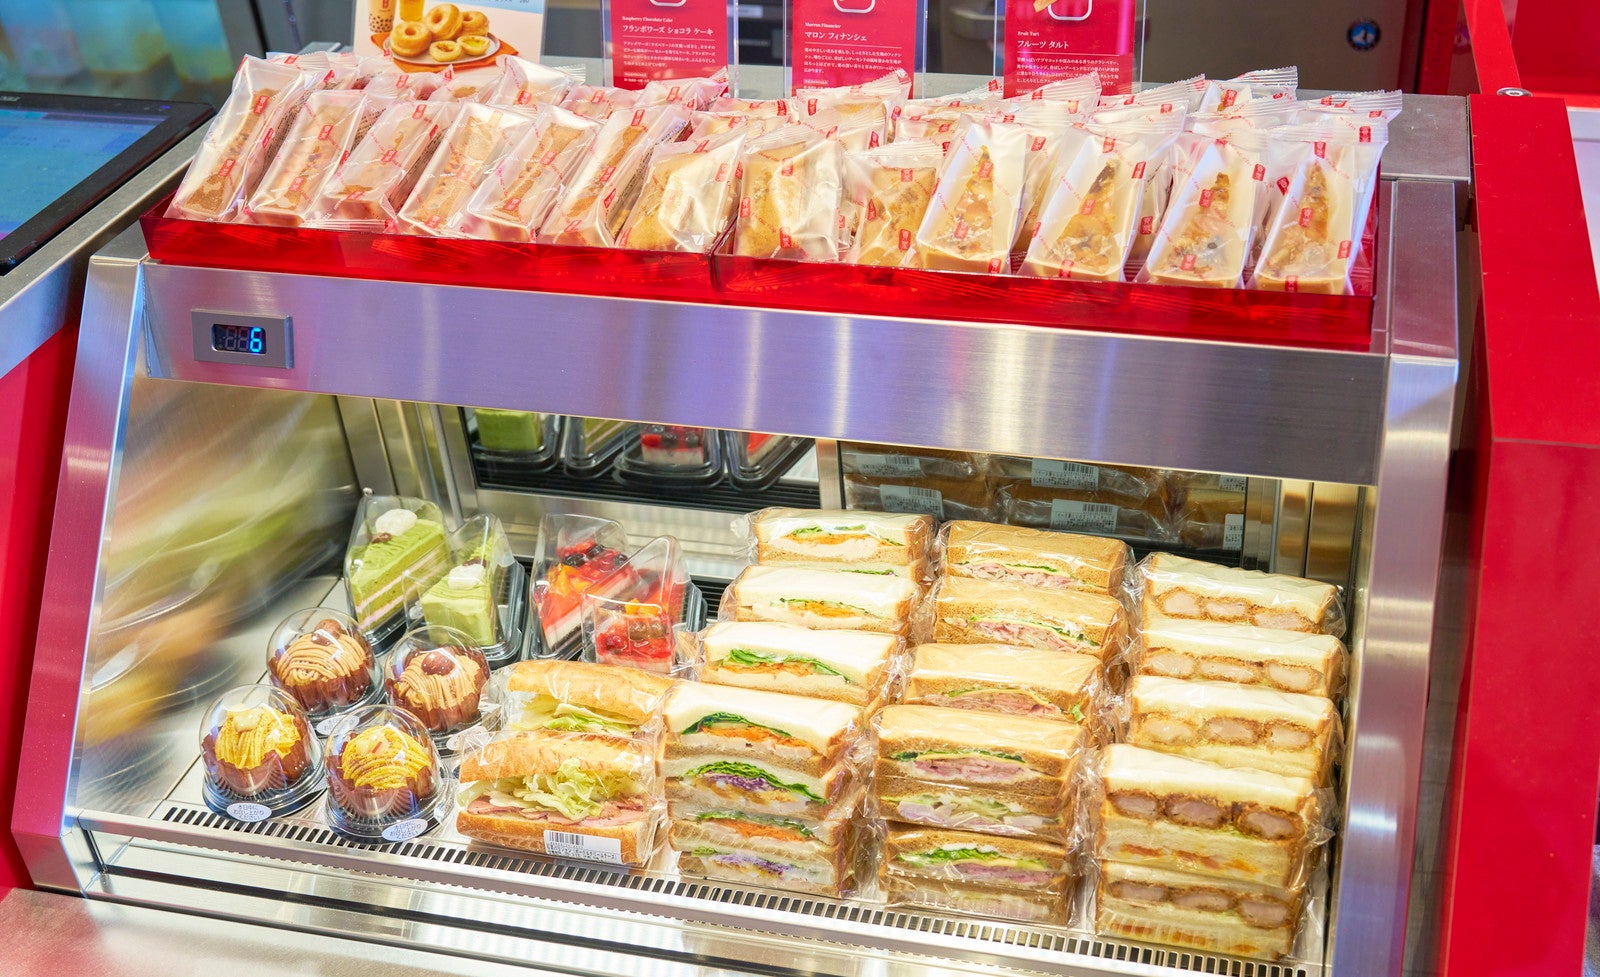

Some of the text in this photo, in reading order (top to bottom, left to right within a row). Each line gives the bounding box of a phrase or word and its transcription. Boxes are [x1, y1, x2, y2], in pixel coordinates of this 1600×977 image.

[668, 27, 692, 35] ショコラ
[694, 28, 714, 36] ケーキ
[805, 31, 867, 41] マロン フィナンシェ
[1017, 40, 1069, 49] フルーツ タルト
[249, 327, 262, 353] 6
